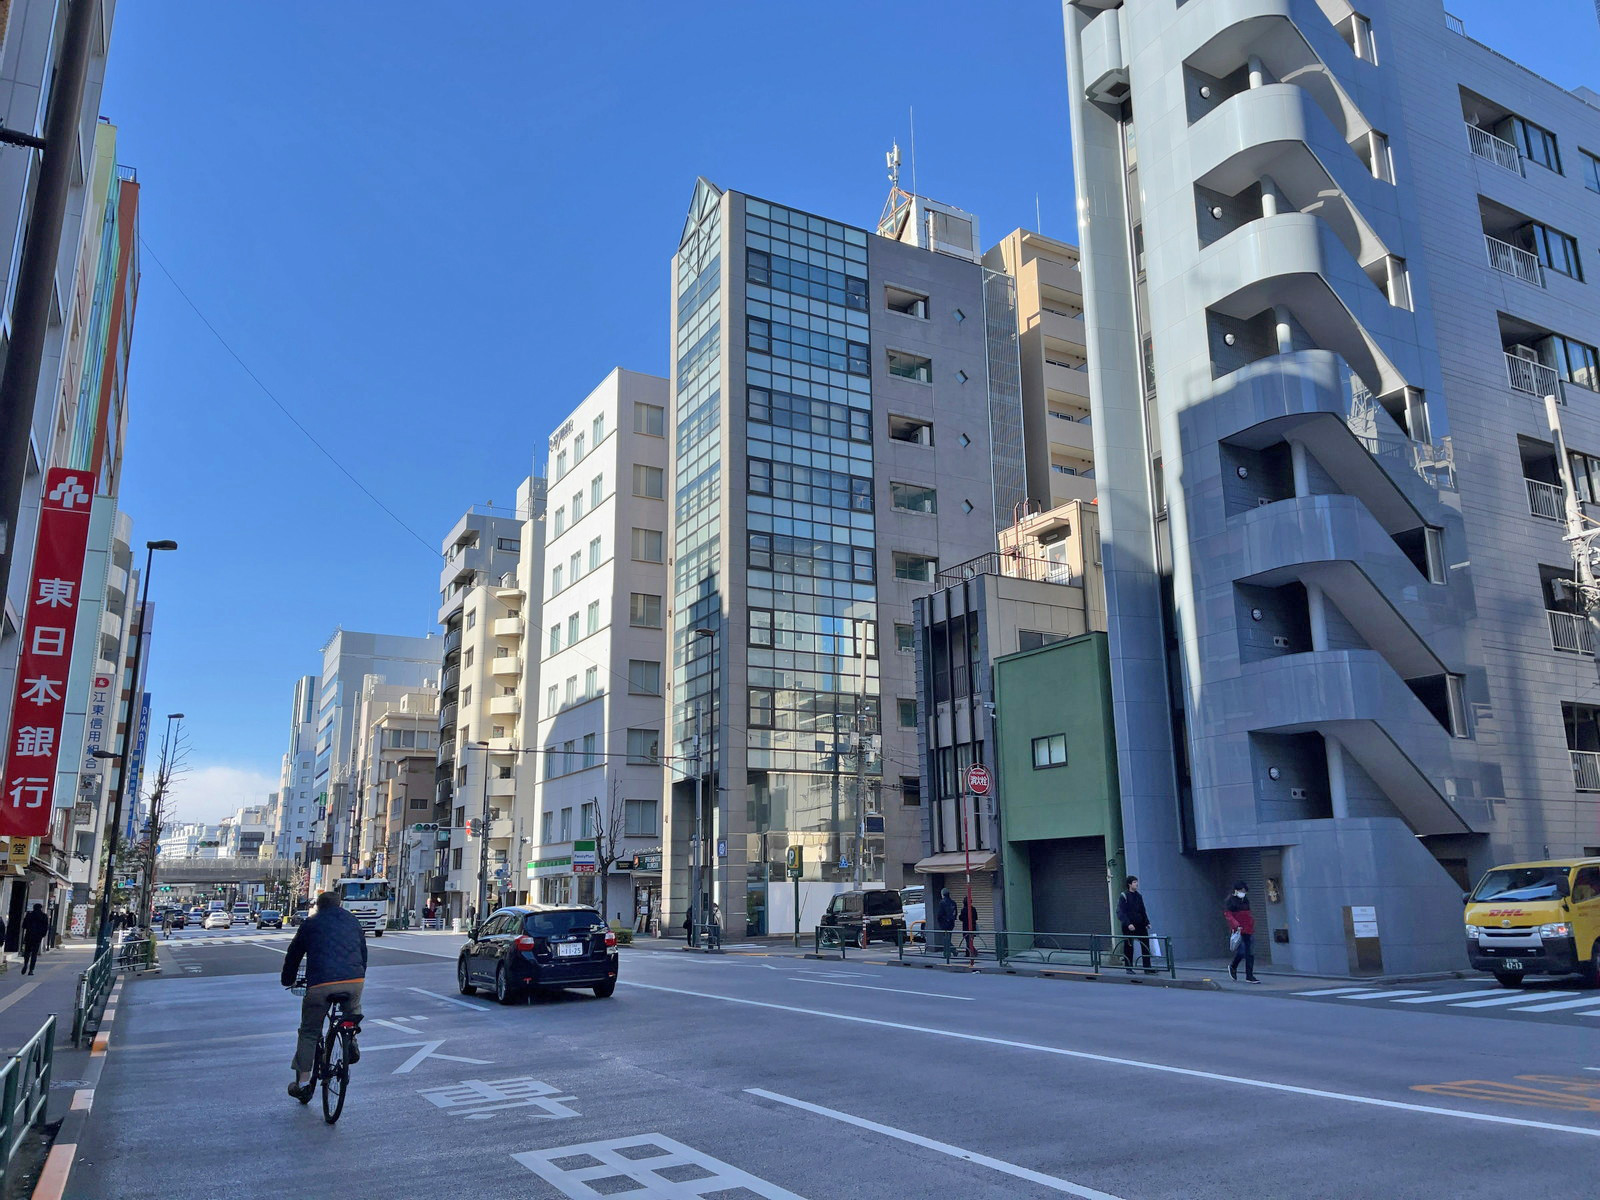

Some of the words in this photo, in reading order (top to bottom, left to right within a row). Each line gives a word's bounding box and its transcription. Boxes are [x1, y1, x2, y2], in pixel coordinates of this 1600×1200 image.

[9, 577, 76, 808] 東日本銀行
[85, 691, 107, 770] 江東信用組合
[789, 850, 795, 865] P
[1488, 909, 1525, 917] DHL
